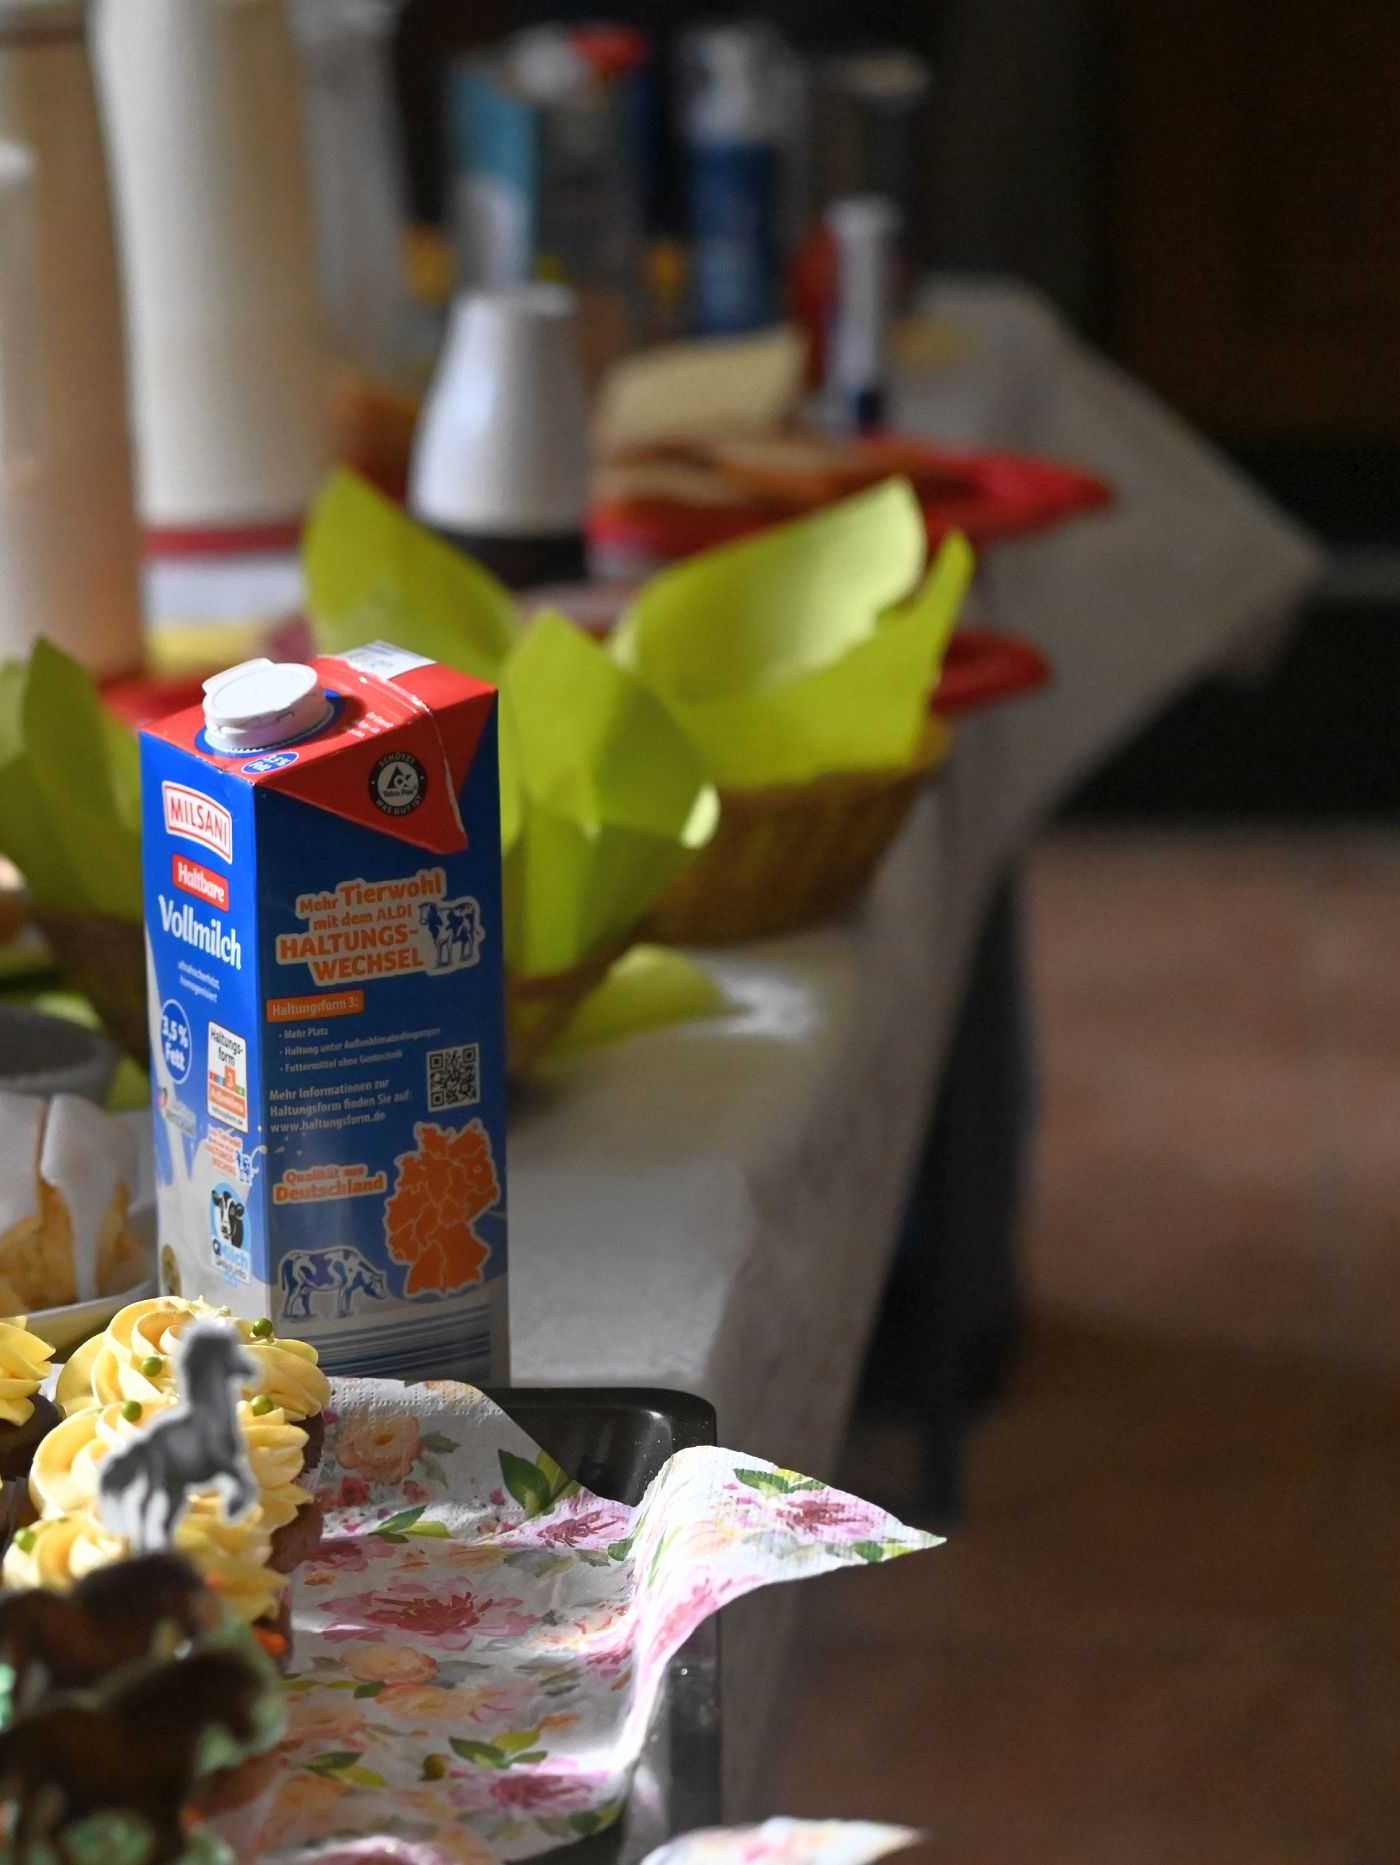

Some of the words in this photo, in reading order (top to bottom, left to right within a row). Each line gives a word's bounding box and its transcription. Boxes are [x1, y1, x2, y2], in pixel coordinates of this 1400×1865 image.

[170, 796, 229, 845] MILSANI
[177, 862, 225, 903] Haltbare
[300, 894, 338, 913] Mehr
[341, 871, 442, 905] Tierwohl
[158, 894, 242, 970] Vollmilch
[313, 915, 338, 930] mit
[341, 910, 373, 928] dem
[376, 903, 413, 922] ALDI
[279, 924, 419, 960] HALTUNGS-
[313, 946, 425, 981] WECHSEL
[272, 998, 345, 1017] Haltungsform
[165, 1041, 186, 1072] Fett
[217, 1047, 235, 1066] form
[269, 1088, 297, 1101] Mehr
[299, 1081, 374, 1099] Informationen
[270, 1100, 342, 1117] Haltungsform
